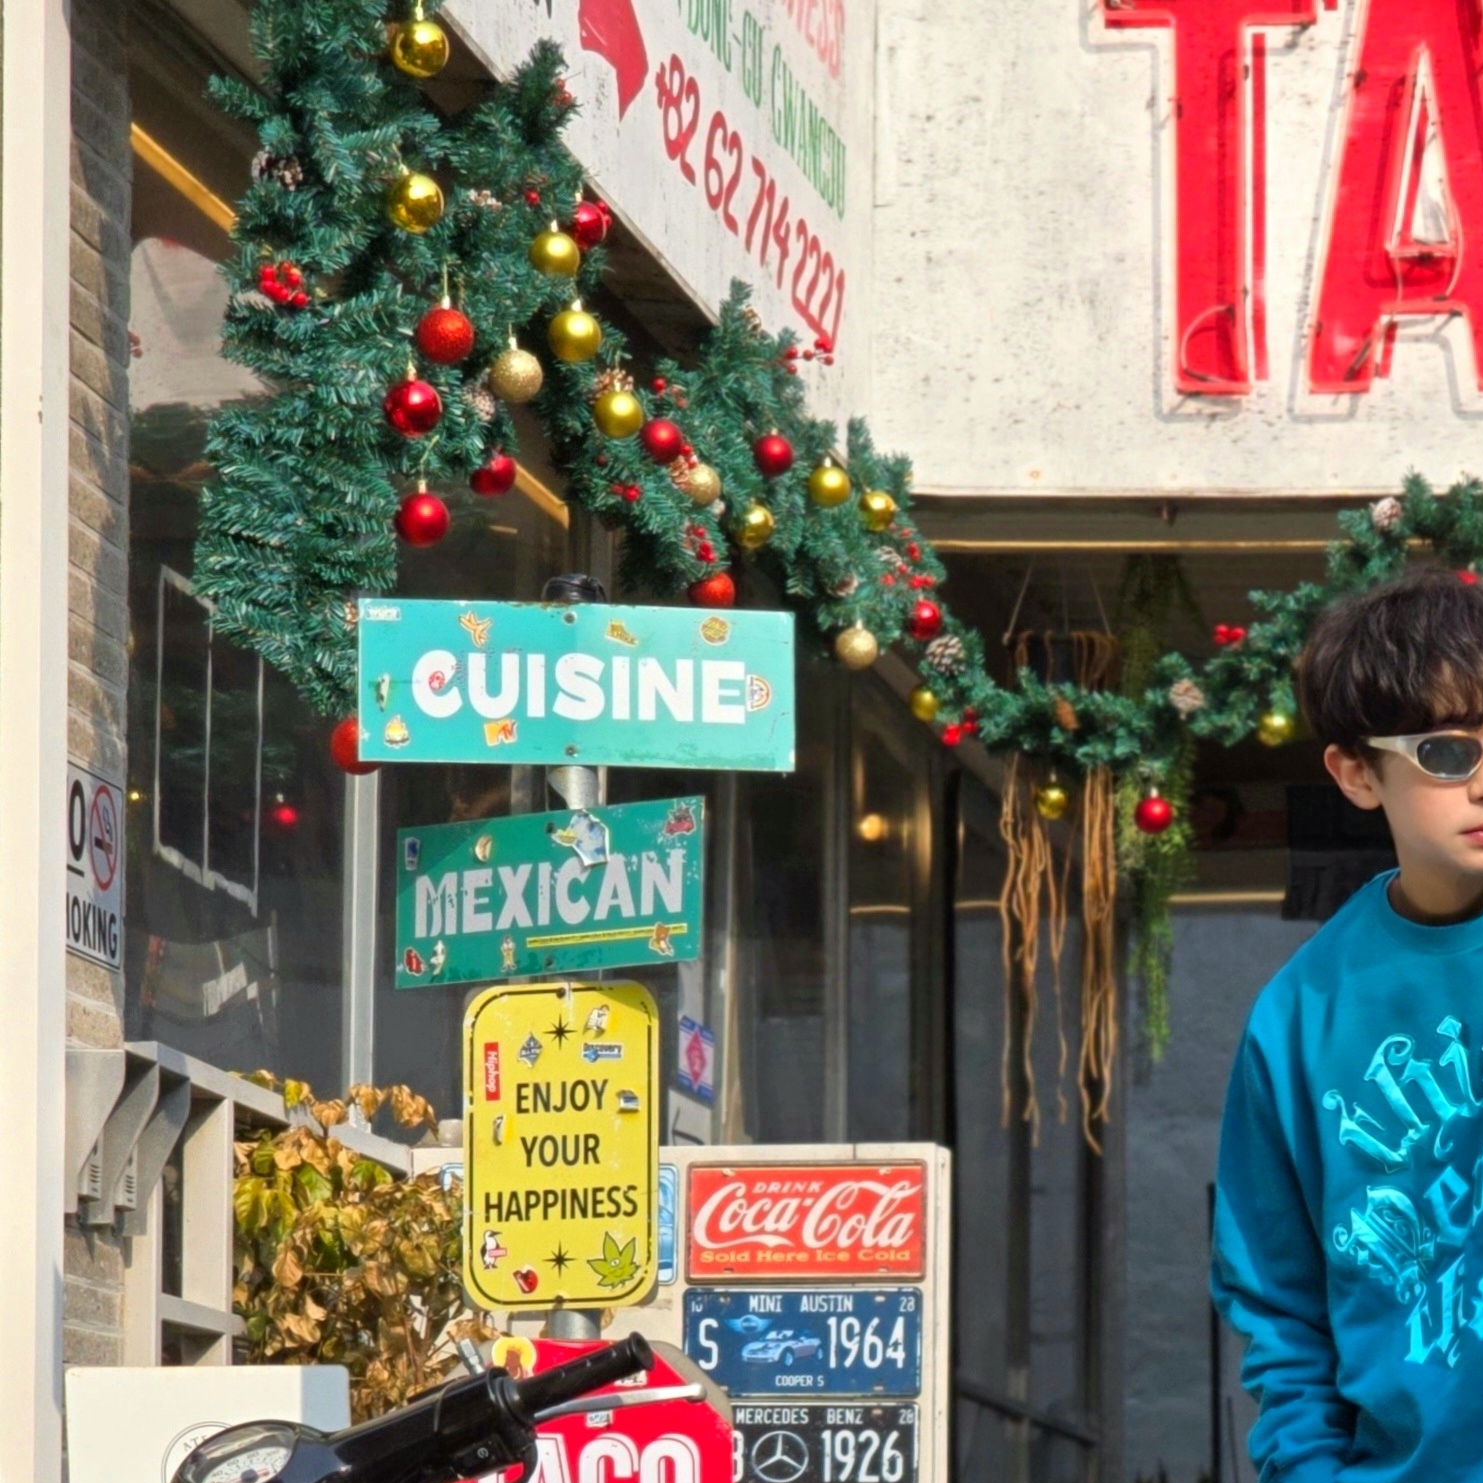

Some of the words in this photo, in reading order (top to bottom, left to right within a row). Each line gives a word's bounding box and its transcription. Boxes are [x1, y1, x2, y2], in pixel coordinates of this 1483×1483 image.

[703, 110, 743, 237] 62
[744, 154, 792, 290] 714
[411, 649, 746, 724] CUISINE
[414, 848, 685, 939] MEXICAN
[516, 1079, 609, 1114] ENJOY
[520, 1133, 601, 1168] YOUR
[484, 1185, 639, 1223] HAPPINESS
[752, 1181, 824, 1194] DRINK
[693, 1180, 923, 1249] Coca-Cola
[700, 1251, 750, 1264] Sold
[756, 1251, 809, 1263] Here
[816, 1250, 849, 1262] Ice
[858, 1250, 911, 1262] Cold
[748, 1295, 783, 1313] MINI
[800, 1295, 854, 1313] AUSTIN
[698, 1318, 719, 1370] S
[826, 1316, 905, 1369] 1964
[775, 1375, 814, 1387] COOPER
[816, 1375, 825, 1386] S
[735, 1408, 810, 1425] MERCEDES
[826, 1408, 864, 1425] BENZ
[821, 1429, 905, 1483] 1926
